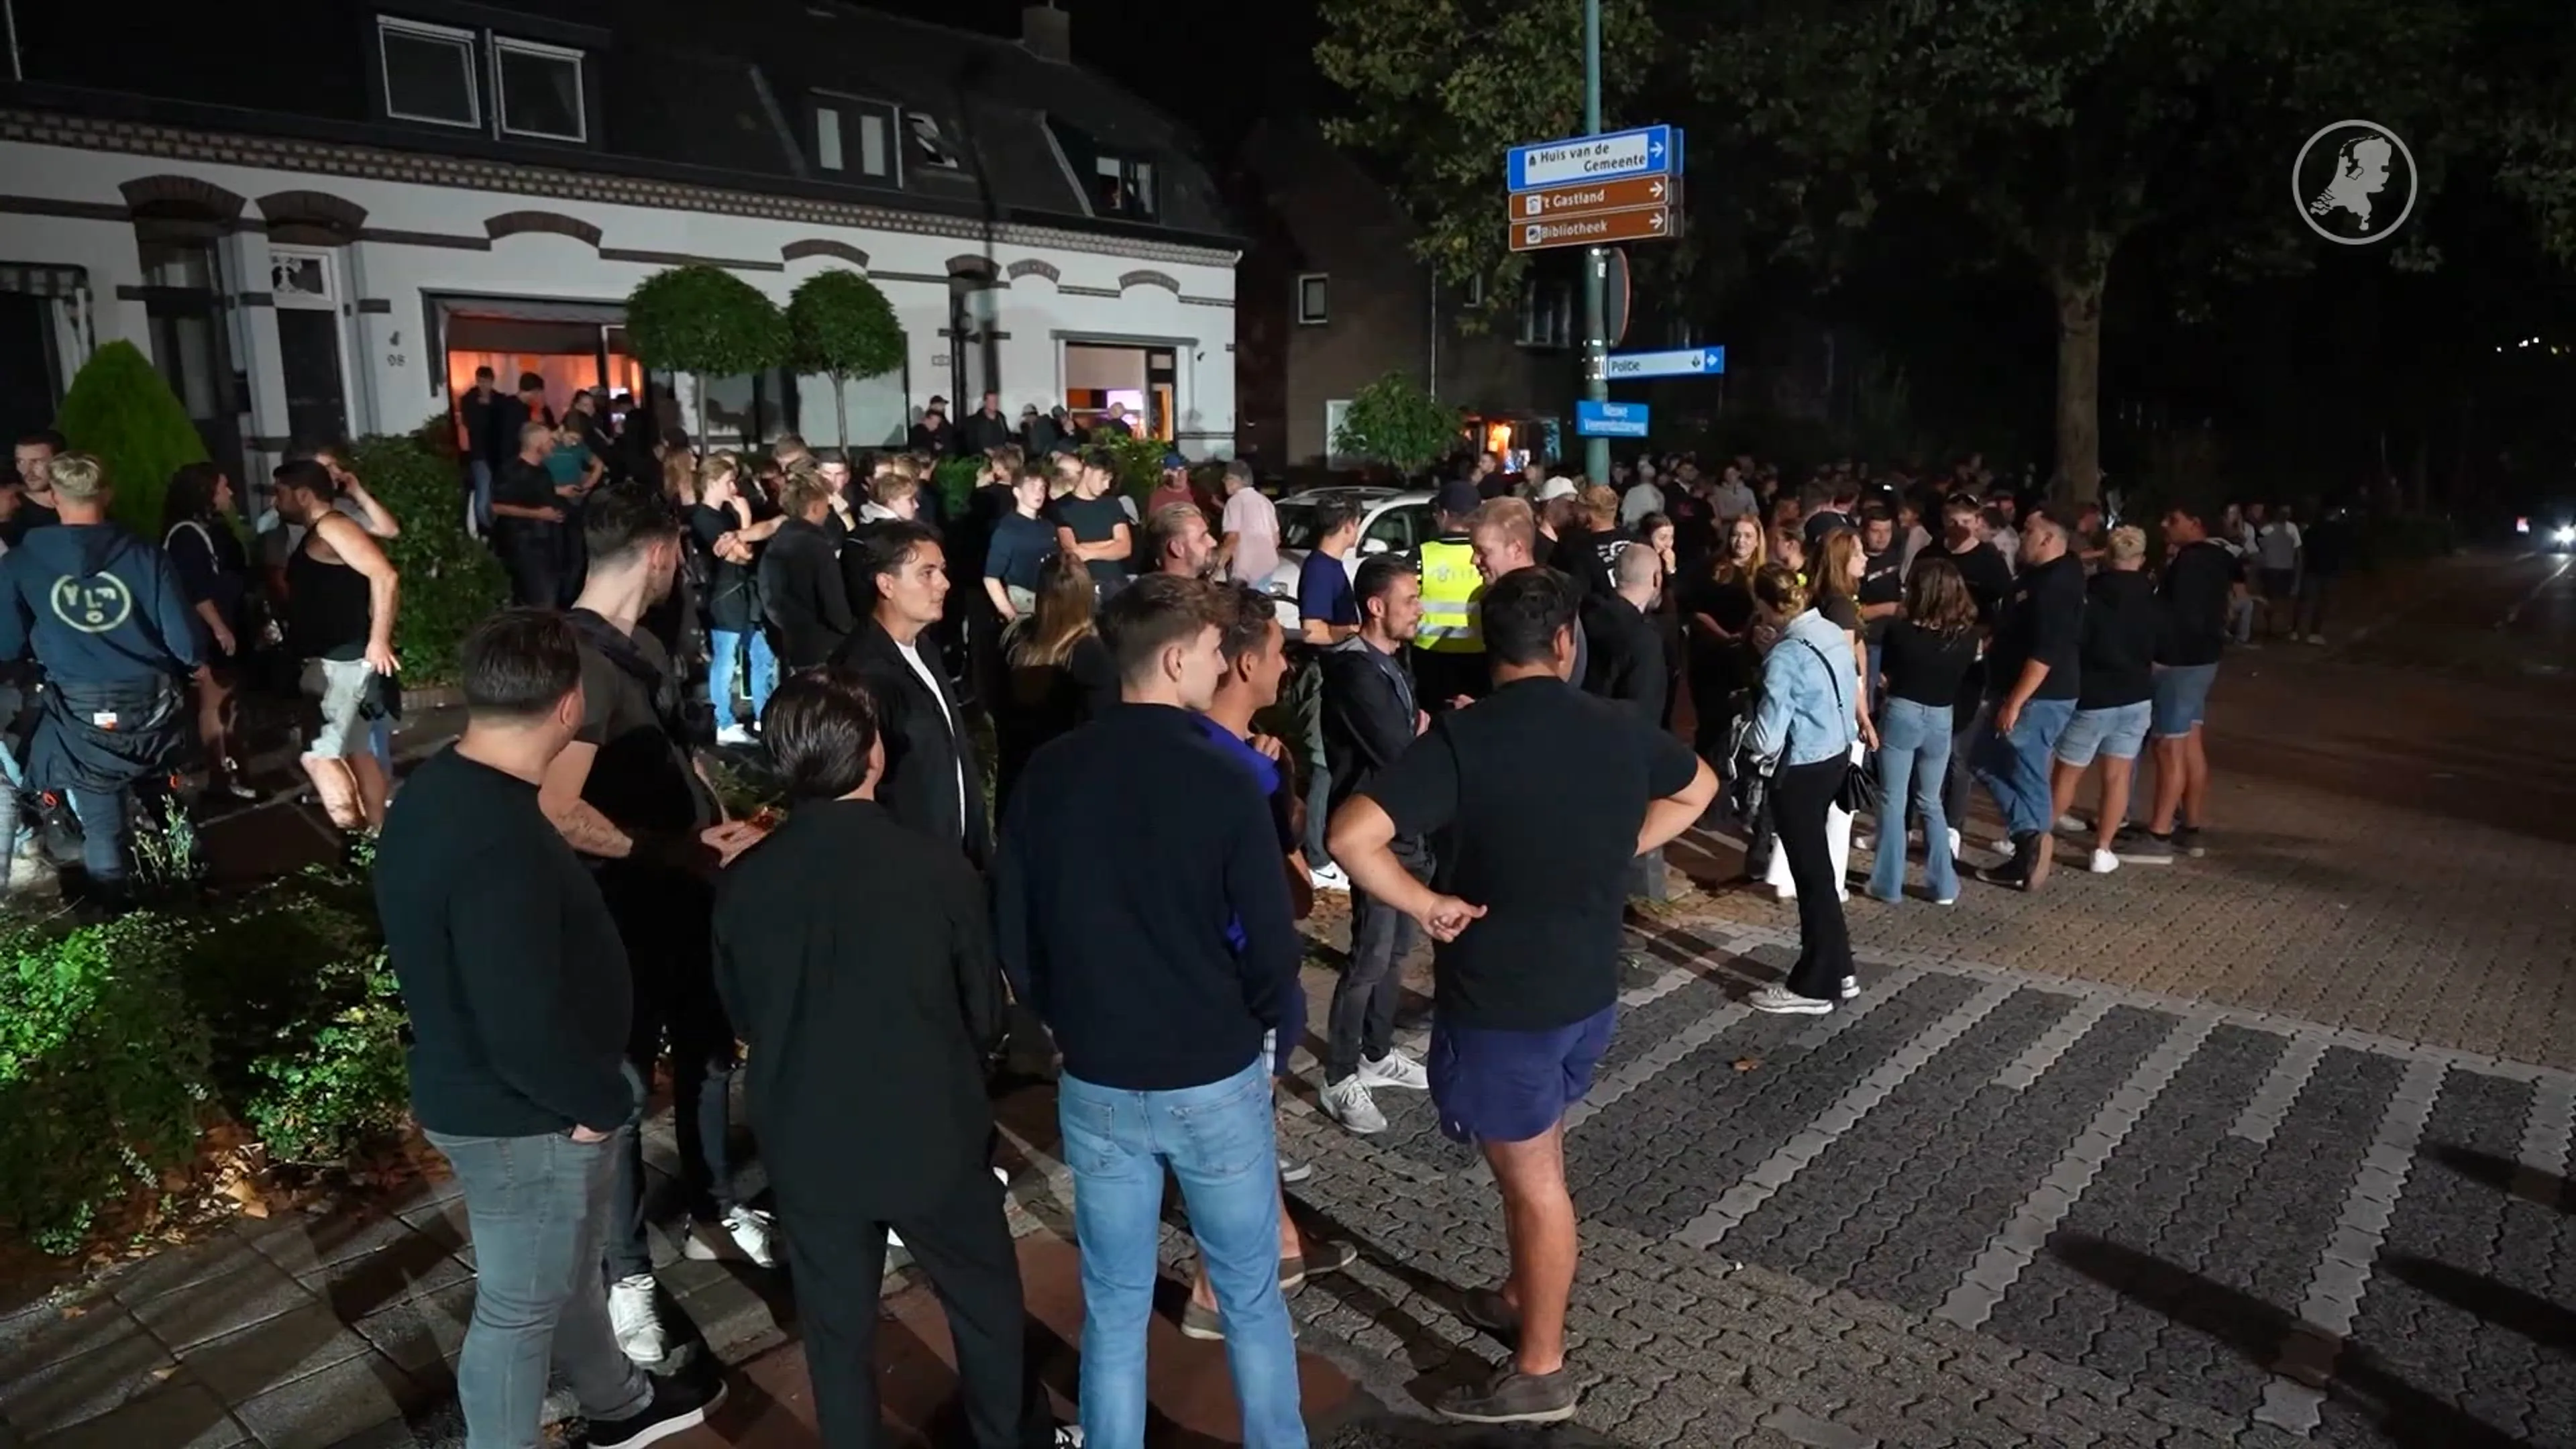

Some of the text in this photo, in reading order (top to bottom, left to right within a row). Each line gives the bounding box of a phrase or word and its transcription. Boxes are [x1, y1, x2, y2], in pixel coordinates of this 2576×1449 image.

[1540, 143, 1610, 164] Huis van de
[1583, 154, 1646, 172] Gemeente
[1542, 219, 1608, 239] Bibliotheek
